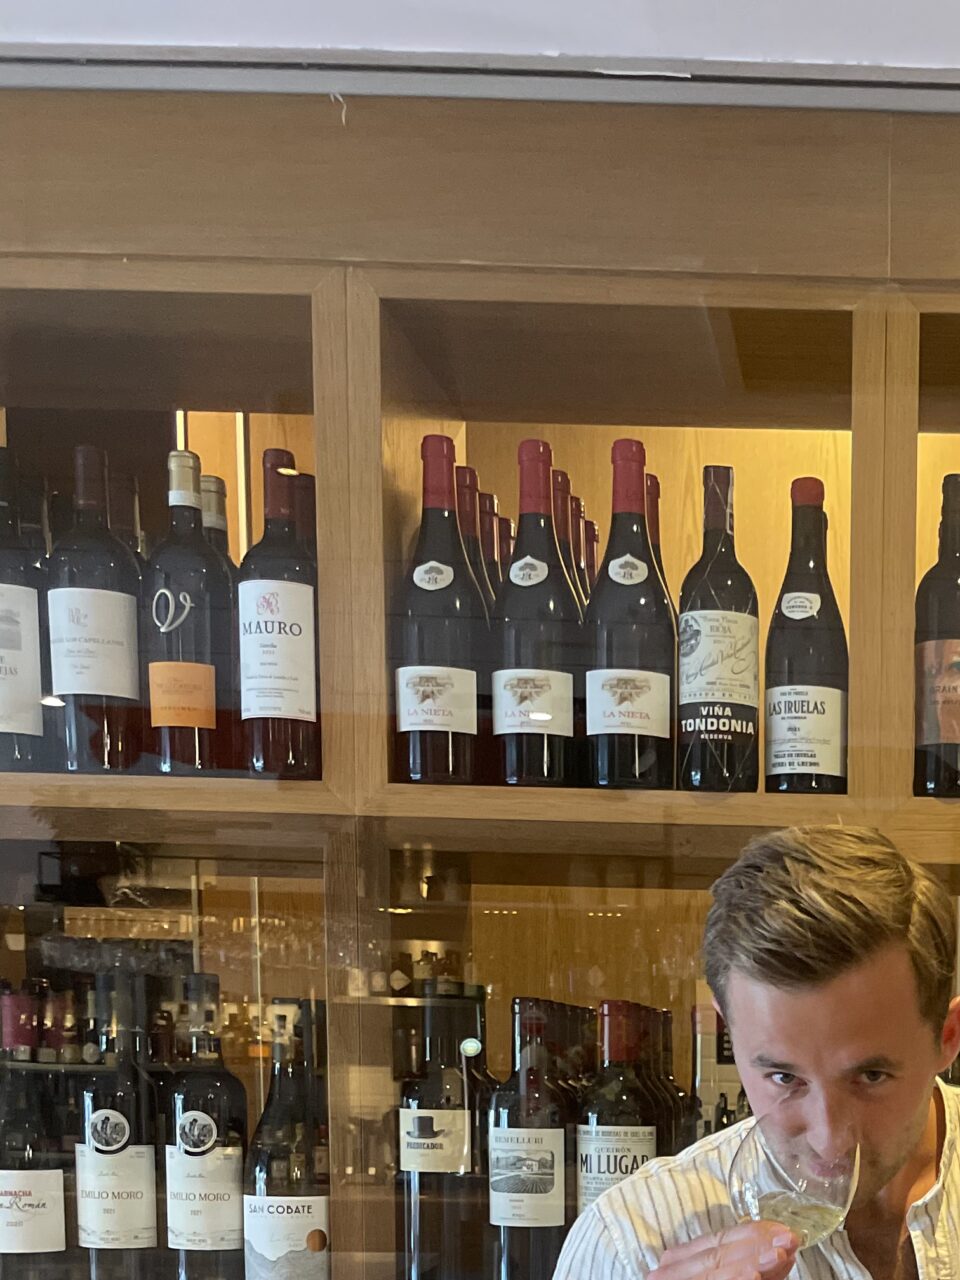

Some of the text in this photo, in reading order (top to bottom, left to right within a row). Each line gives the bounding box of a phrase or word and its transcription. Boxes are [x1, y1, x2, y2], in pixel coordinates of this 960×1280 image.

[242, 620, 302, 637] MAURO
[407, 709, 454, 717] LA NIETA
[700, 704, 732, 716] VIÑA
[768, 700, 826, 717] LAS IRUELAS
[602, 710, 651, 720] LA NIETA
[681, 718, 755, 735] TONDONIA
[700, 733, 732, 741] RESERVA
[580, 1153, 593, 1174] MI
[80, 1190, 144, 1200] EMILIO MORO
[169, 1191, 231, 1202] EMILIO MORO
[249, 1204, 313, 1215] SAN COBATE
